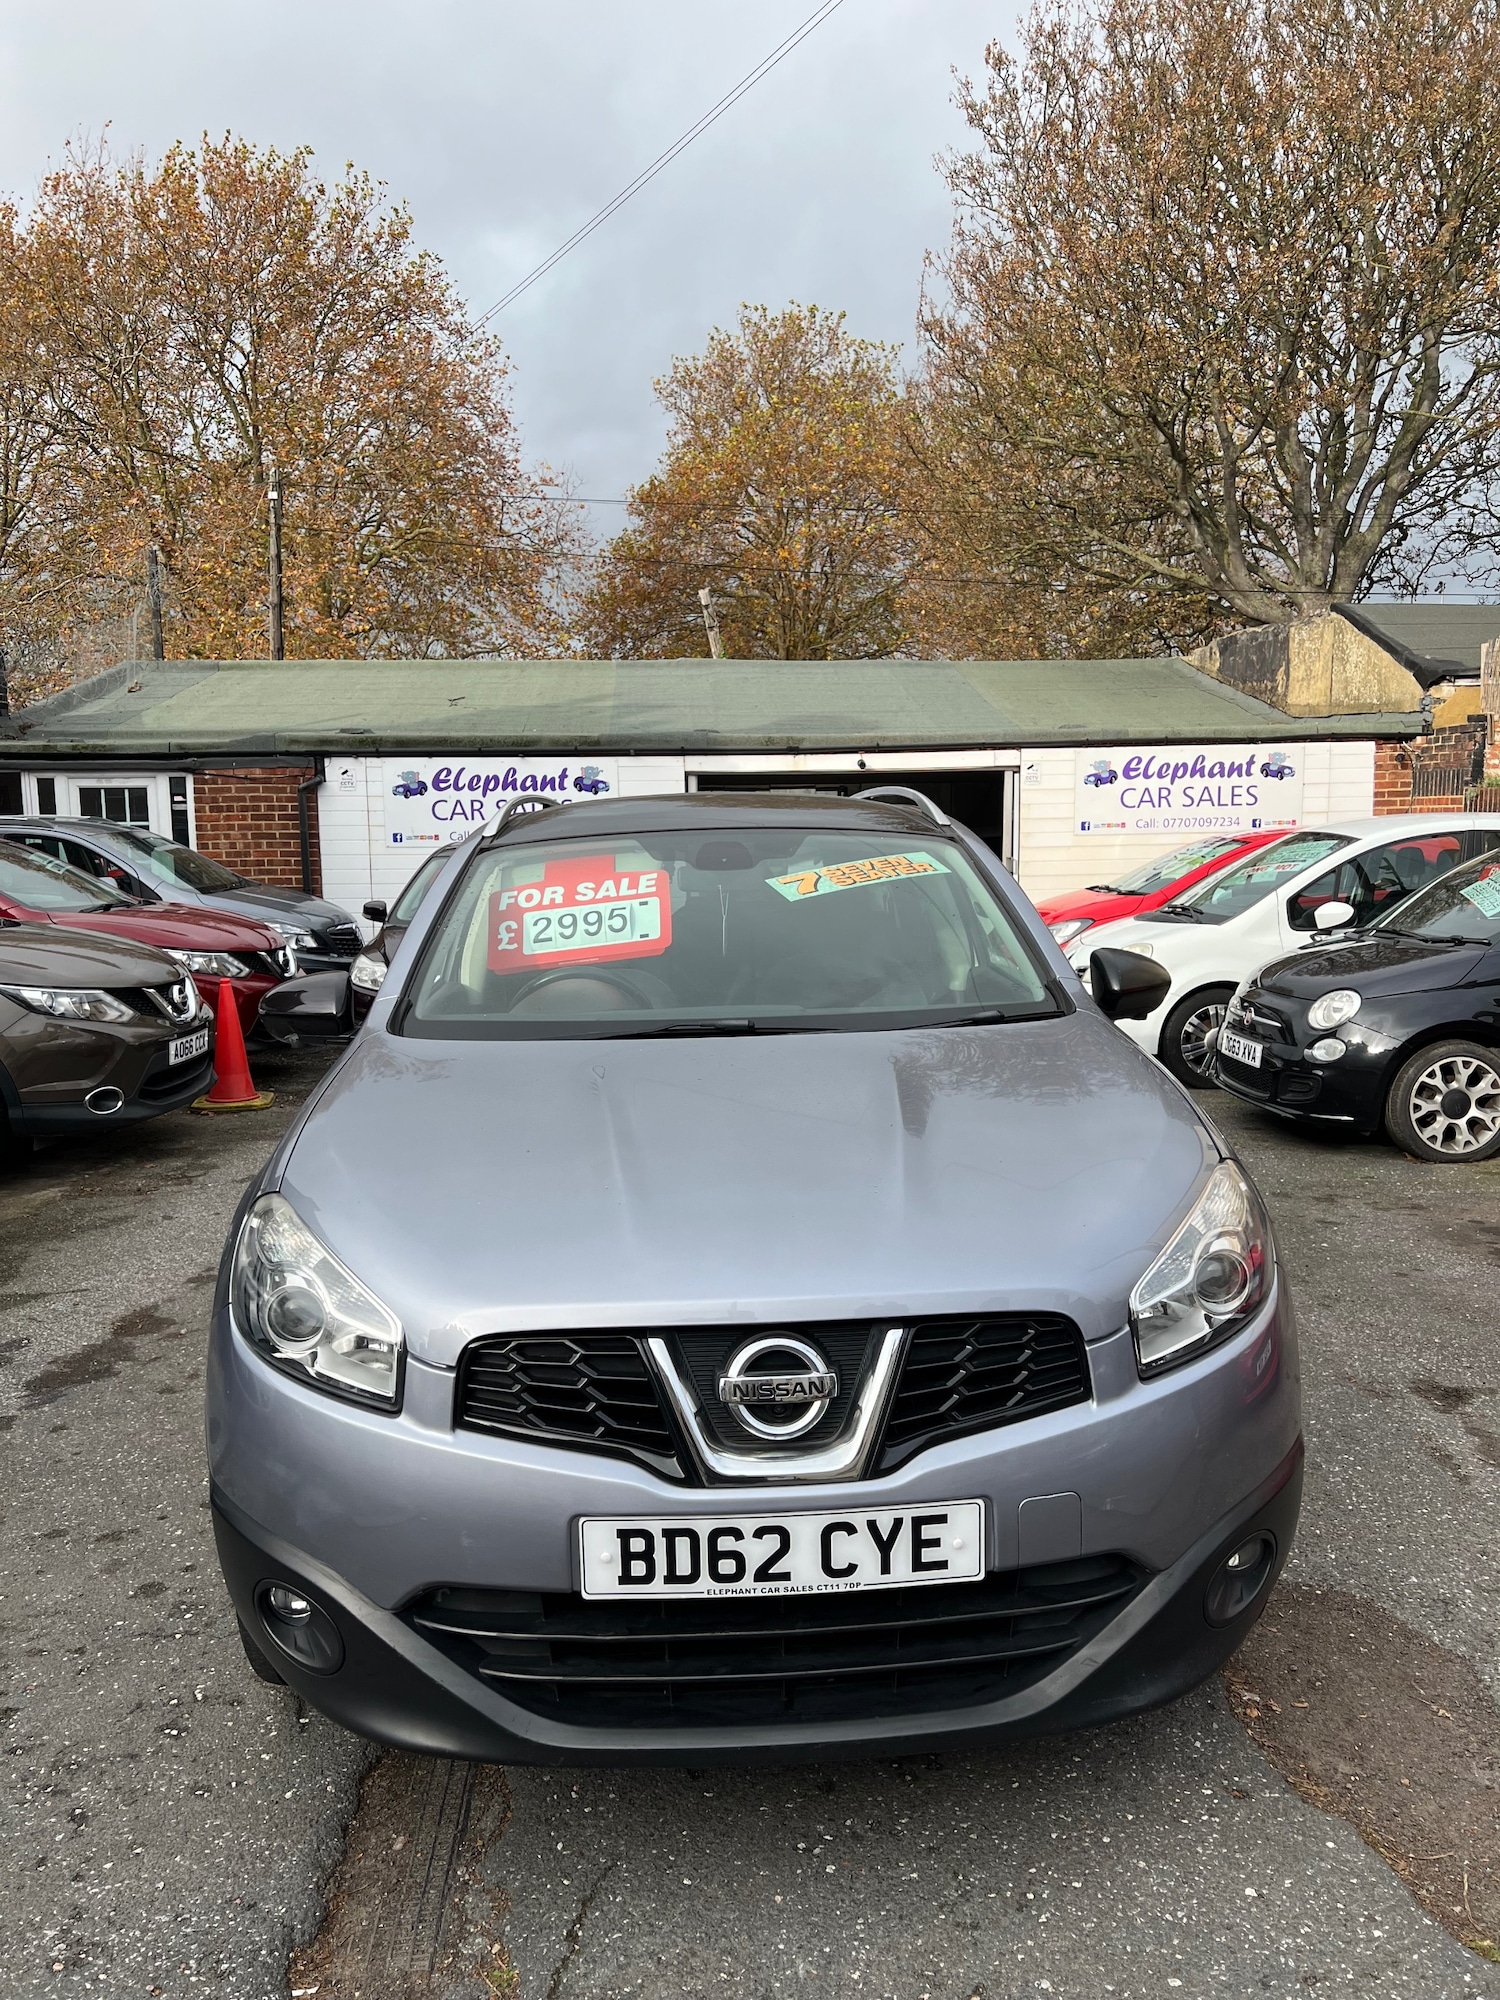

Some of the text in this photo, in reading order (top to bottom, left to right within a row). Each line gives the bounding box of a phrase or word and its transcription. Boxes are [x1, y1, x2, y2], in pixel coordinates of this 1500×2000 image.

[1121, 754, 1256, 785] Elephant
[431, 767, 568, 798] Elephant
[1120, 785, 1259, 809] CAR SALES
[431, 799, 486, 821] CAR
[1135, 819, 1160, 829] Call:
[1163, 817, 1241, 828] 07707097234
[820, 856, 912, 877] SEVEN
[831, 862, 937, 887] SEATER
[1274, 863, 1299, 871] MOT
[498, 873, 658, 911] FOR SALE
[532, 906, 628, 944] 2995
[732, 1380, 825, 1398] NISSAN
[616, 1514, 949, 1585] BD62 CYE
[707, 1587, 759, 1595] ELEPHANT
[783, 1584, 814, 1592] SALES
[816, 1582, 841, 1591] CT11
